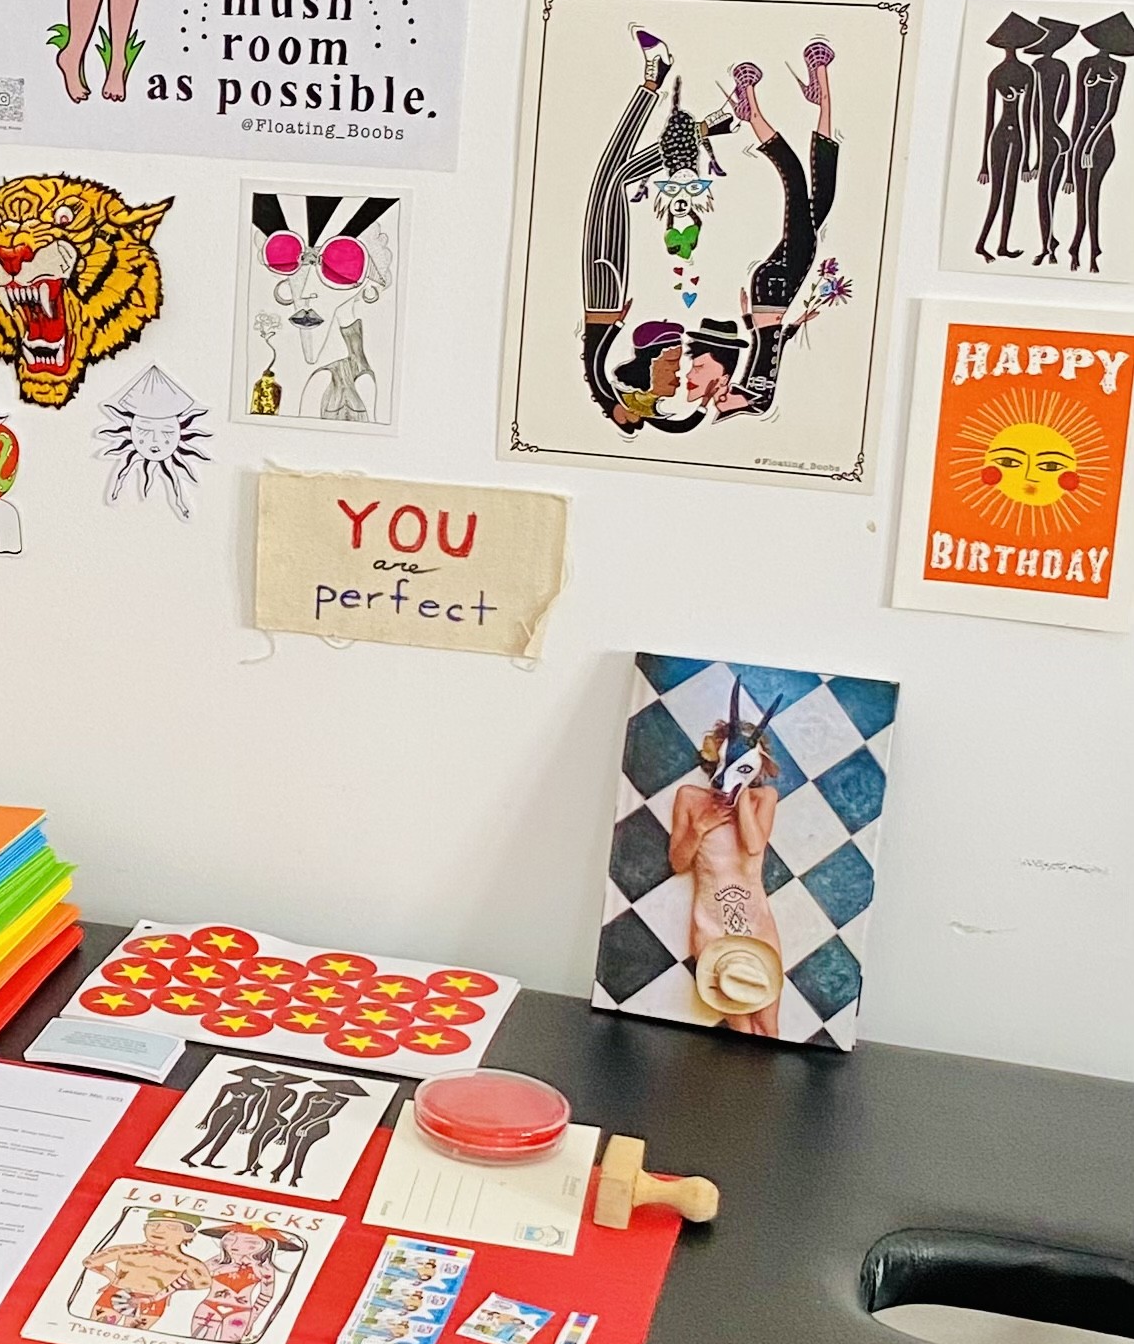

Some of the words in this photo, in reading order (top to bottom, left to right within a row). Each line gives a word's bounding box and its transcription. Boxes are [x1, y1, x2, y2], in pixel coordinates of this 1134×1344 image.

[221, 33, 348, 67] room
[146, 74, 194, 102] as
[216, 73, 438, 120] possible.
[240, 117, 405, 141] @Floating_Boobs
[951, 341, 1130, 395] HAPPY
[754, 458, 841, 472] @Floating_Boobs
[337, 498, 478, 559] YOU
[372, 559, 441, 575] are
[930, 530, 1110, 585] BIRTHDAY
[315, 578, 498, 626] perfect
[123, 1187, 209, 1212] LOVE
[220, 1202, 325, 1232] SUCKS
[68, 1321, 131, 1343] Tattoos
